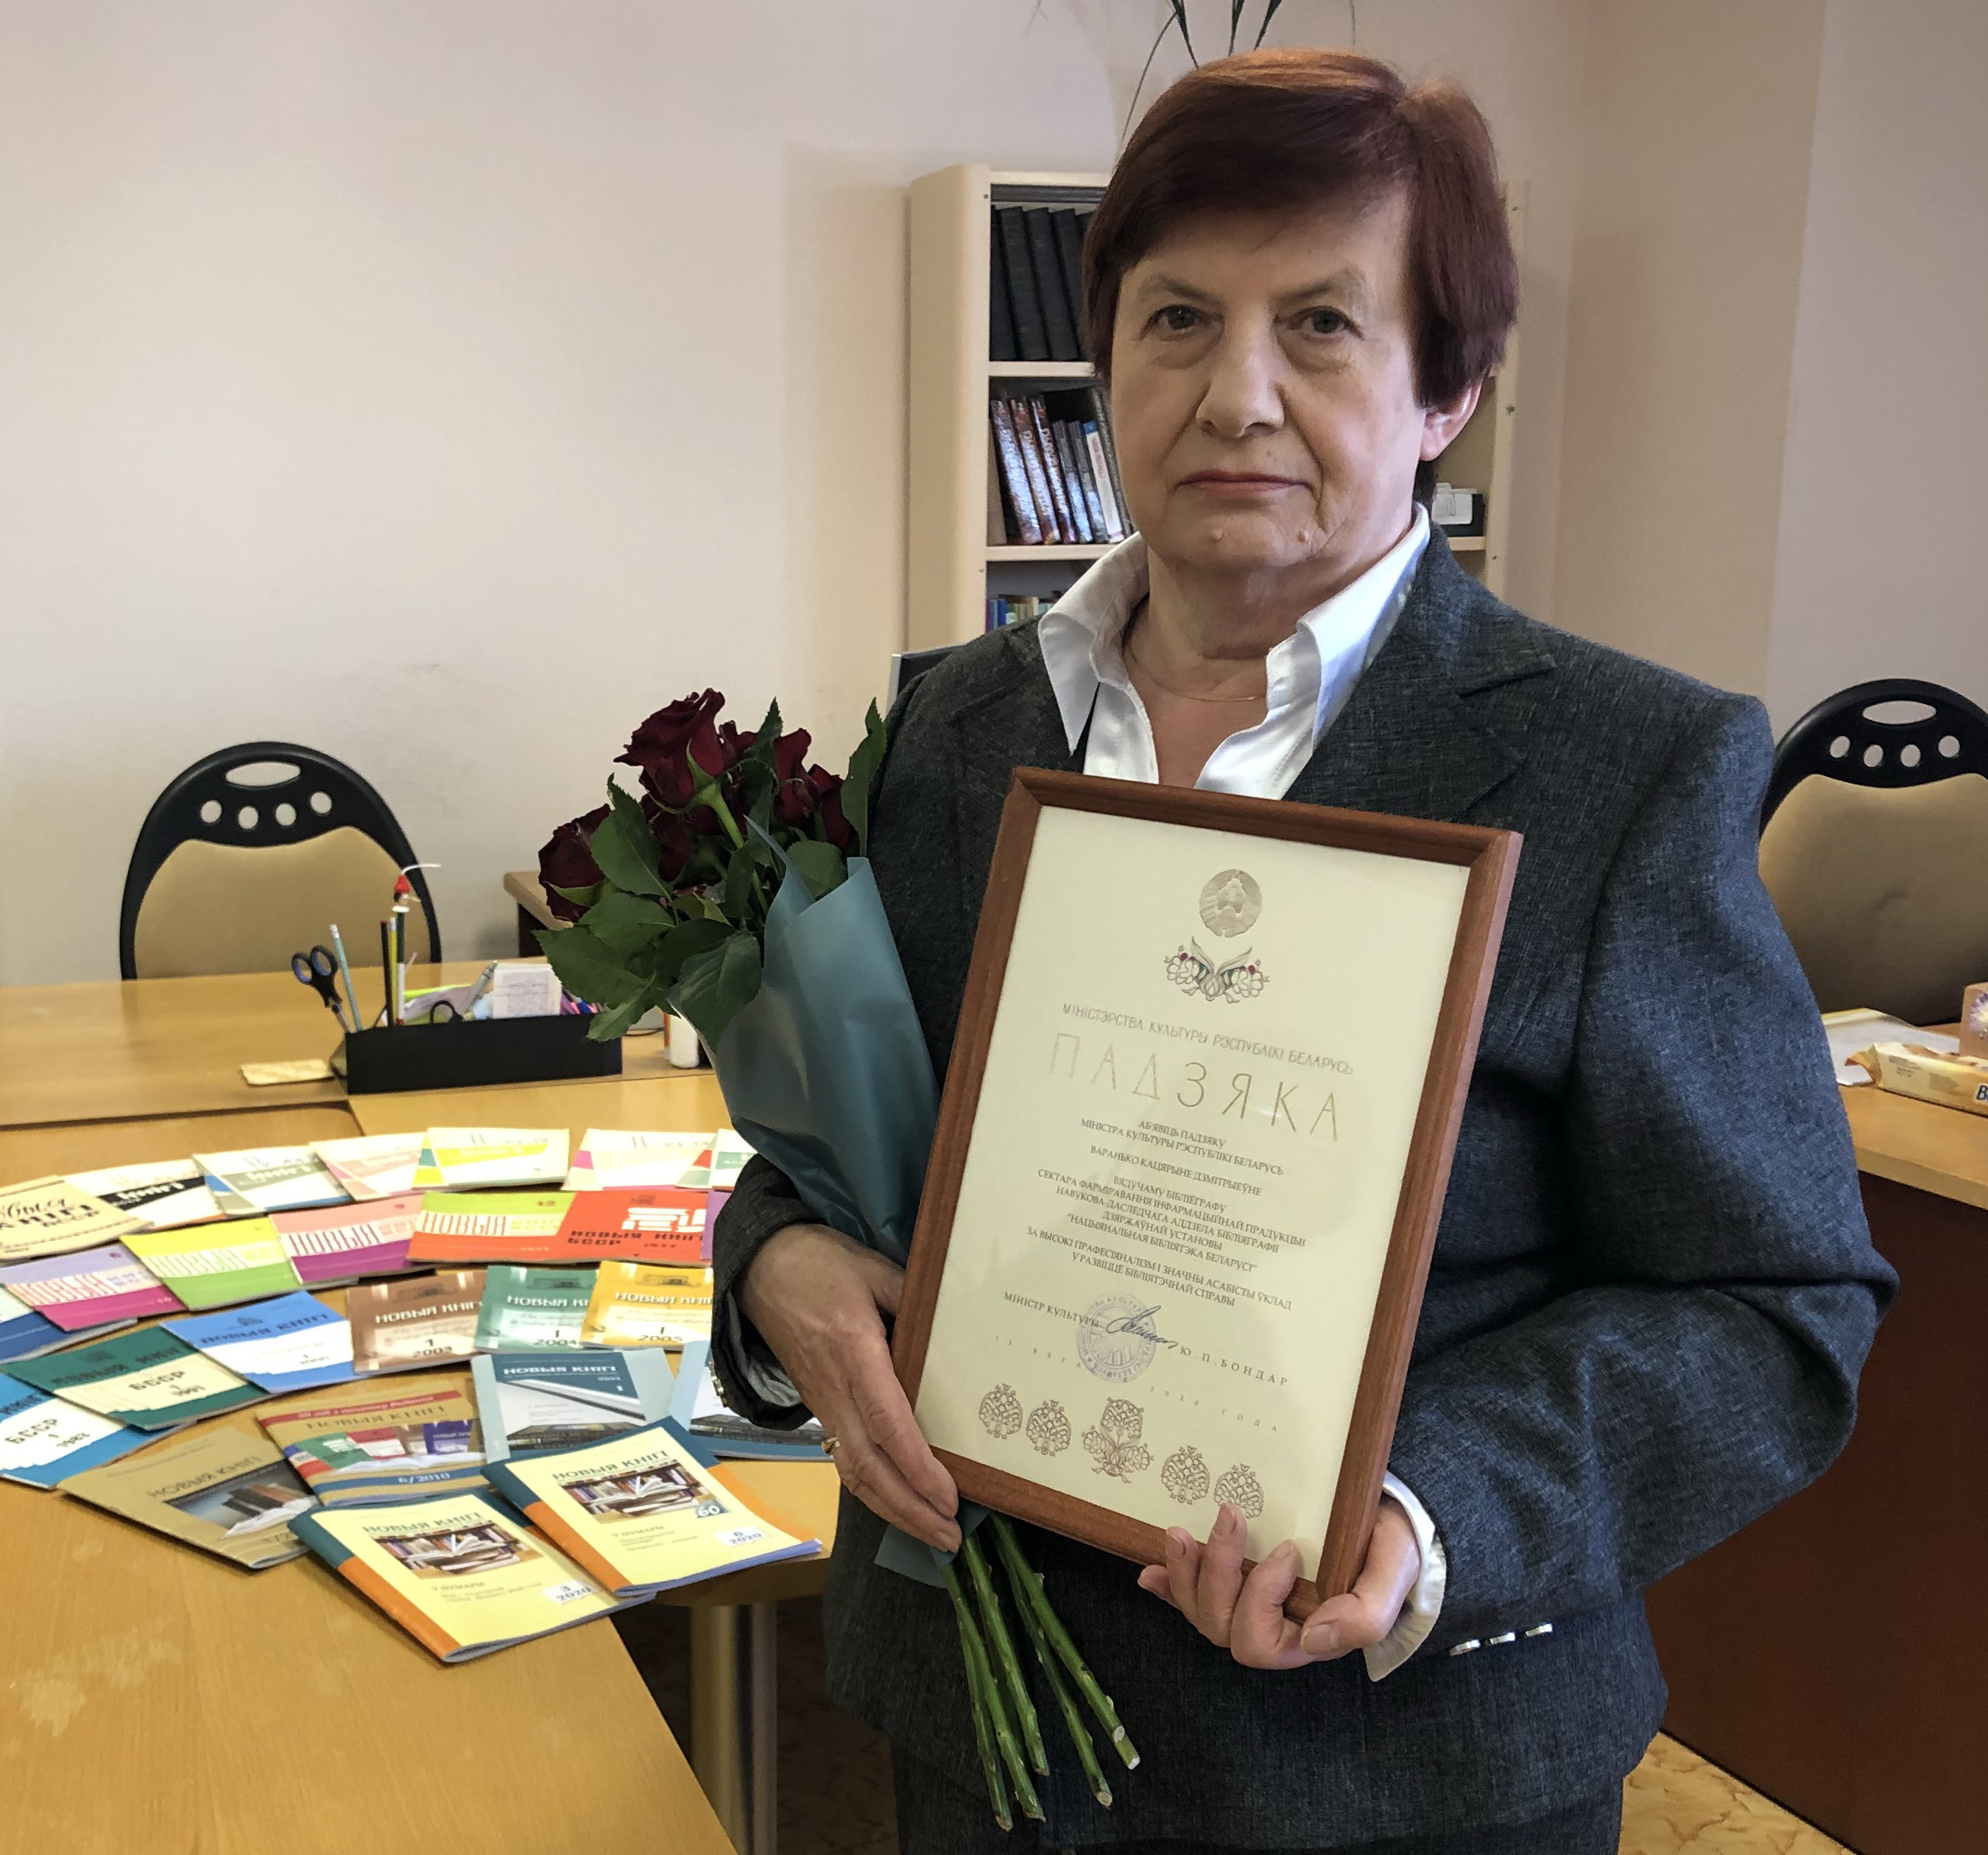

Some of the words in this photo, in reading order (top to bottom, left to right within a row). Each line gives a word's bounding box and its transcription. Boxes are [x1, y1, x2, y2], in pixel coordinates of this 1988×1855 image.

[1062, 1004, 1143, 1030] МІНІСТЭРСТВА
[1149, 1021, 1208, 1043] КУЛЬТУРЫ
[1213, 1034, 1284, 1060] РЭСПУБЛІКІ
[1288, 1051, 1353, 1074] БЕЛАРУСЬ
[1049, 1032, 1337, 1141] ПАДЗЯКА
[1080, 1119, 1124, 1136] МІНІСТРА
[1126, 1130, 1174, 1148] КУЛЬТУРЫ
[1176, 1141, 1233, 1163] РЭСПУБЛІКІ
[1233, 1156, 1283, 1176] БЕЛАРУСЬ
[1180, 1130, 1227, 1149] ПАДЗЯКУ
[1090, 1145, 1139, 1164] ВАРАНЬКО
[1140, 1158, 1192, 1178] КАЦЯРЫНЕ
[1193, 1172, 1263, 1196] ДЗМІТРЫЕЎНЕ
[1113, 1176, 1165, 1197] ВЯДУЧАМУ
[1166, 1189, 1227, 1214] БІБЛІЁГРАФУ
[1037, 1169, 1077, 1186] СЕКТАРА
[1079, 1180, 1152, 1205] ФАРМІРАВАННЯ
[1154, 1200, 1244, 1231] ІНФАРМАЦЫЙНАЙ
[1245, 1224, 1307, 1247] ПРАДУКЦЫІ
[1056, 1186, 1168, 1223] НАВУКОВА-ДАСЛЕДЧАГА
[1171, 1217, 1214, 1236] АДДЗЕЛА
[1216, 1229, 1280, 1253] БІБЛІЯГРАФІІ
[422, 1212, 507, 1236] НОВЫЯ
[571, 1231, 642, 1239] НОВЫЯ
[1102, 1211, 1167, 1236] ДЗЯРЖАЎНАЙ
[1169, 1228, 1223, 1250] УСТАНОВЫ
[288, 1224, 381, 1256] НОВЫЯ
[567, 1237, 621, 1246] БССР
[1149, 1236, 1203, 1259] БІБЛІЯТЭКА
[1027, 1226, 1037, 1237] ЗА
[1039, 1230, 1073, 1246] ВЫСОКІ
[1074, 1240, 1157, 1271] ПРАФЕСІЯНАЛІЗМ
[1157, 1264, 1161, 1272] І
[1163, 1265, 1205, 1285] ЗНАЧНЫ
[1205, 1278, 1256, 1300] АСАБІСТЫ
[1258, 1292, 1292, 1310] ЎКЛАД
[615, 1292, 676, 1304] НОВЫЯ
[1125, 1267, 1193, 1295] БІБЛІЯТЭЧНАЙ
[1194, 1288, 1236, 1306] СПРАВЫ
[507, 1295, 568, 1307] НОВЫЯ
[1004, 1292, 1045, 1310] МІНІСТР
[1046, 1306, 1100, 1328] КУЛЬТУРЫ
[376, 1306, 437, 1324] НОВЫЯ
[200, 1328, 272, 1344] НОВЫЯ
[277, 1313, 328, 1330] КНІГІ
[555, 1329, 560, 1338] 1
[660, 1326, 665, 1334] 1
[425, 1338, 434, 1346] 1
[128, 1370, 186, 1390] БССР
[504, 1366, 567, 1375] НОВЫЯ
[306, 1415, 384, 1429] НОВЫЯ
[390, 1405, 445, 1420] КНІГІ
[4, 1418, 58, 1444] БССР
[146, 1471, 217, 1498] НОВЫЯ
[216, 1455, 261, 1474] КНІГІ
[552, 1463, 618, 1479] НОВЫЯ
[621, 1450, 669, 1468] КНІГІ
[398, 1473, 451, 1484] 6/2010
[362, 1521, 430, 1534] НОВЫЯ
[434, 1512, 482, 1527] КНІГІ
[698, 1505, 720, 1517] 60
[728, 1532, 762, 1544] 2020
[557, 1586, 591, 1601] 2020
